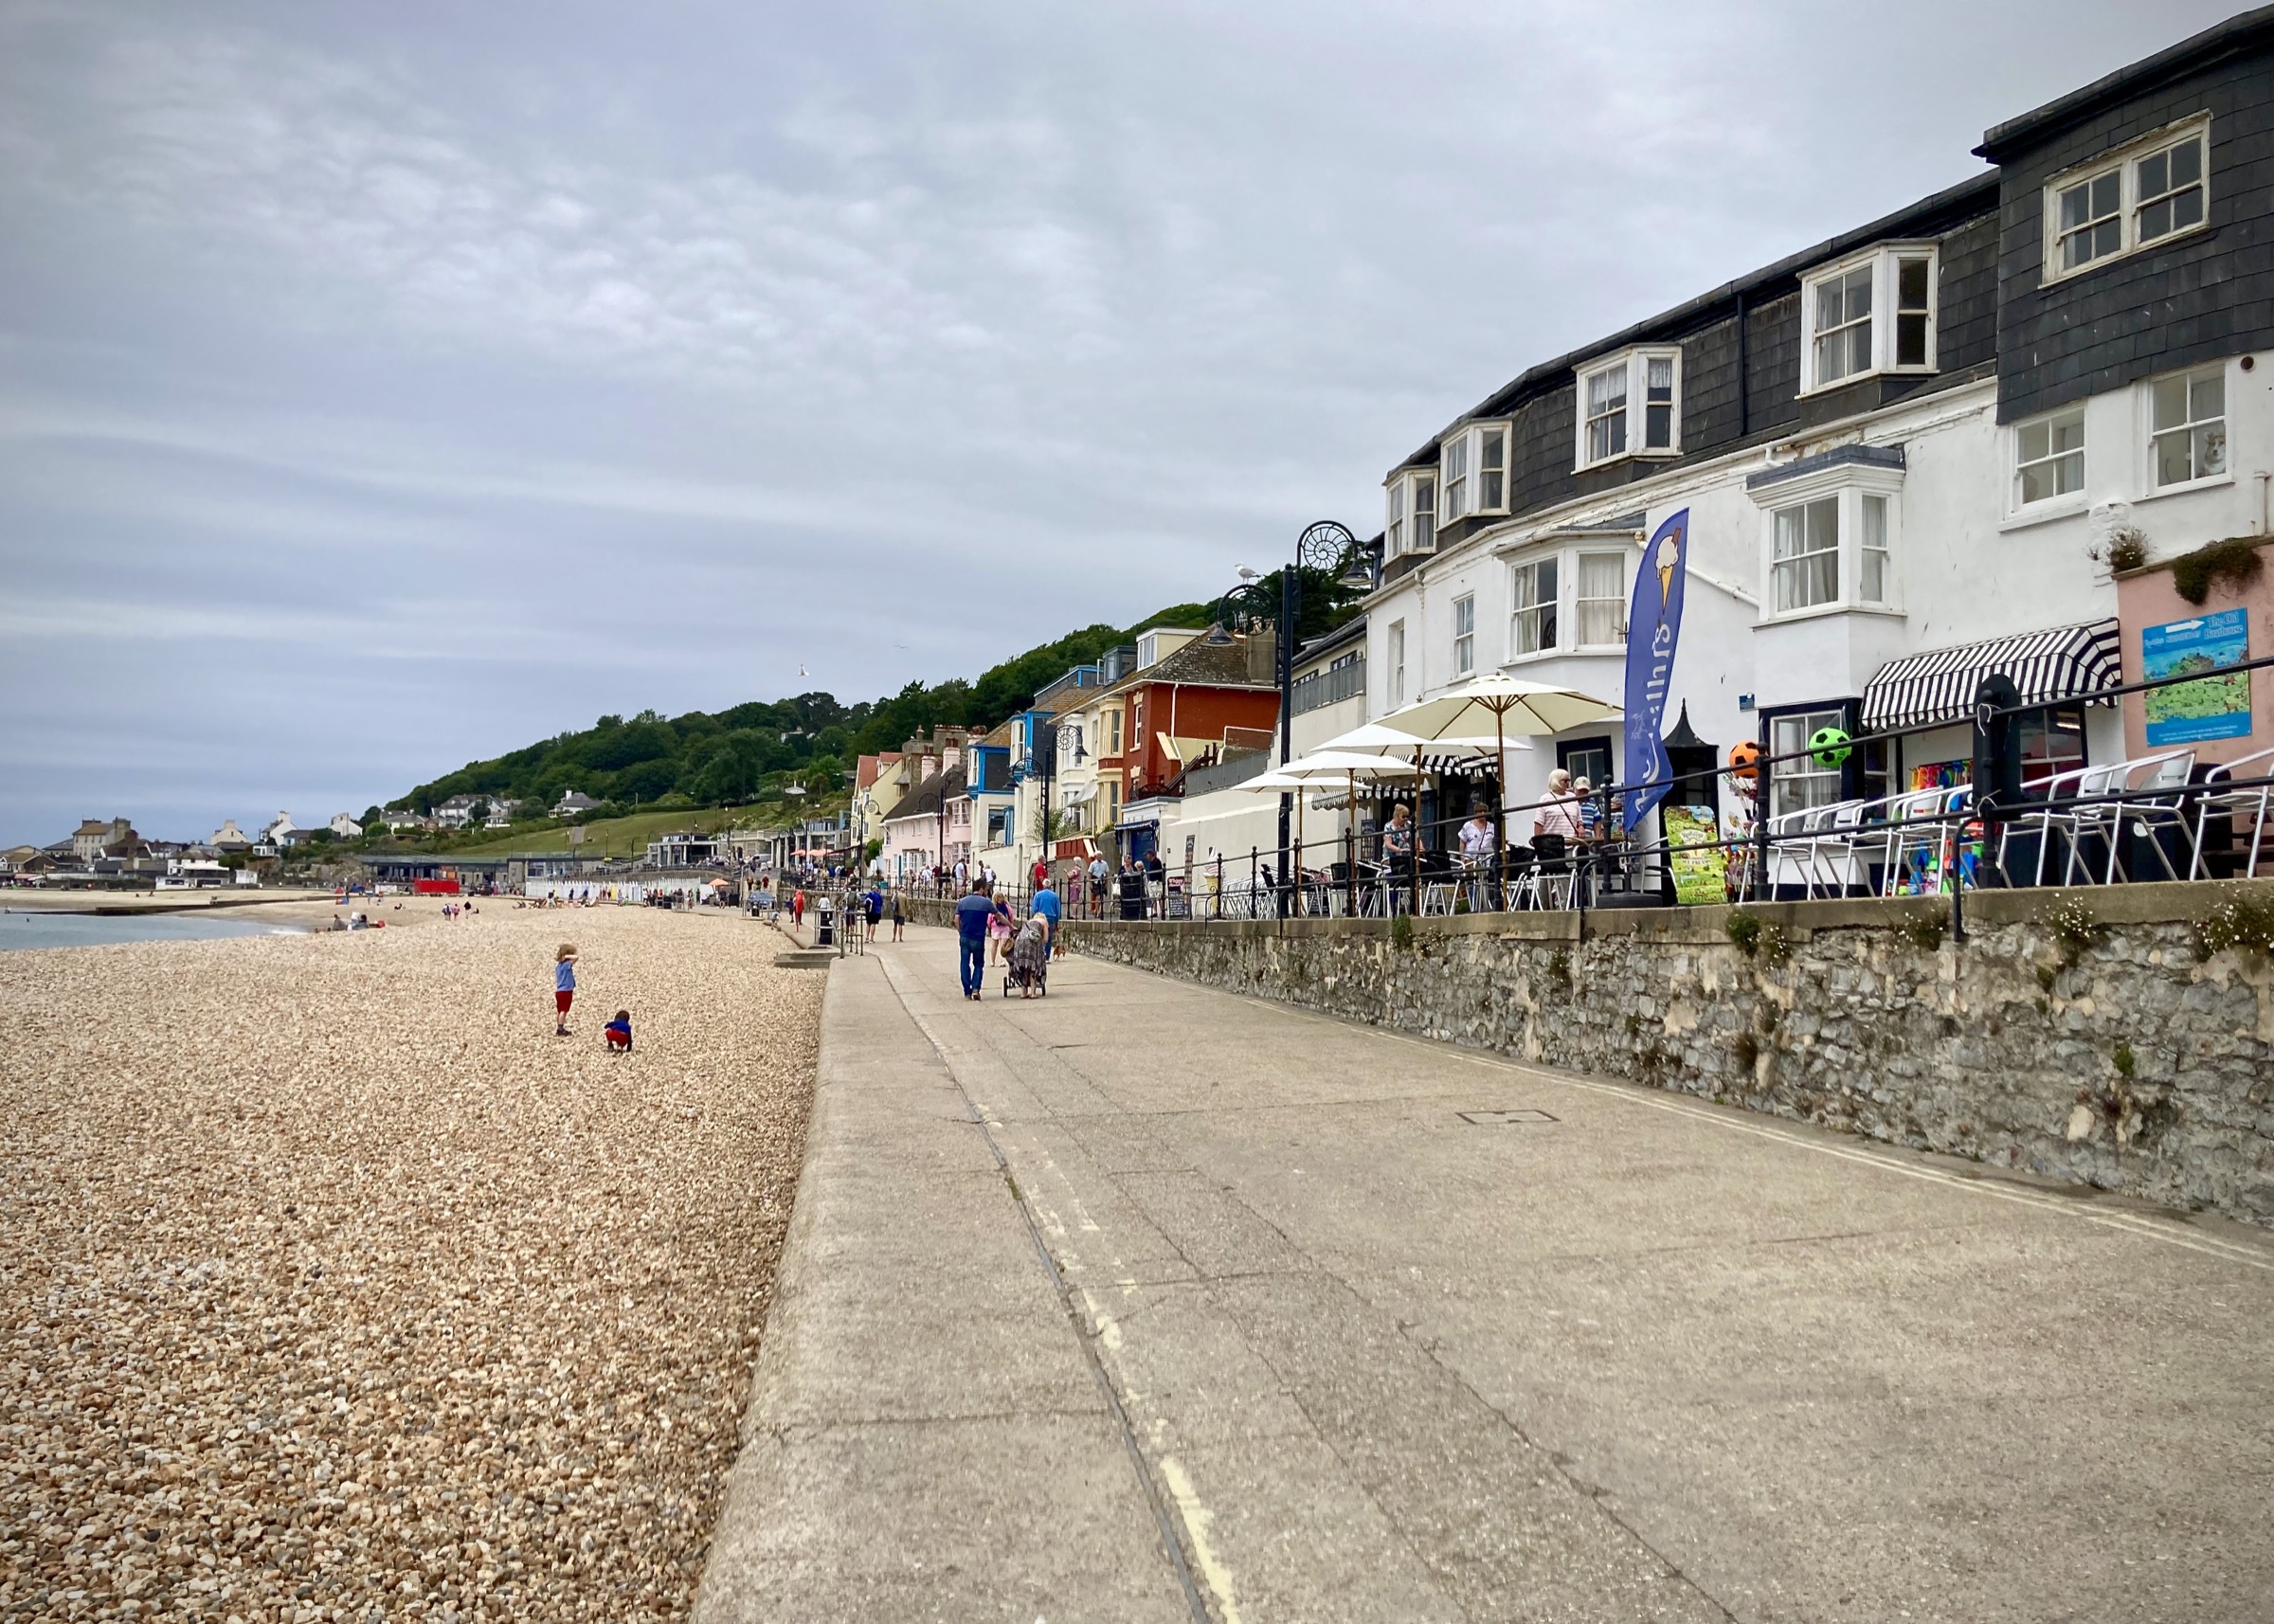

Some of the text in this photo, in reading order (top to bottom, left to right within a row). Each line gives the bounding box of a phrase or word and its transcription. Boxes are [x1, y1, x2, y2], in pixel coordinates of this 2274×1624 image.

[2209, 612, 2239, 627] The Old
[2205, 625, 2243, 639] Boathouse
